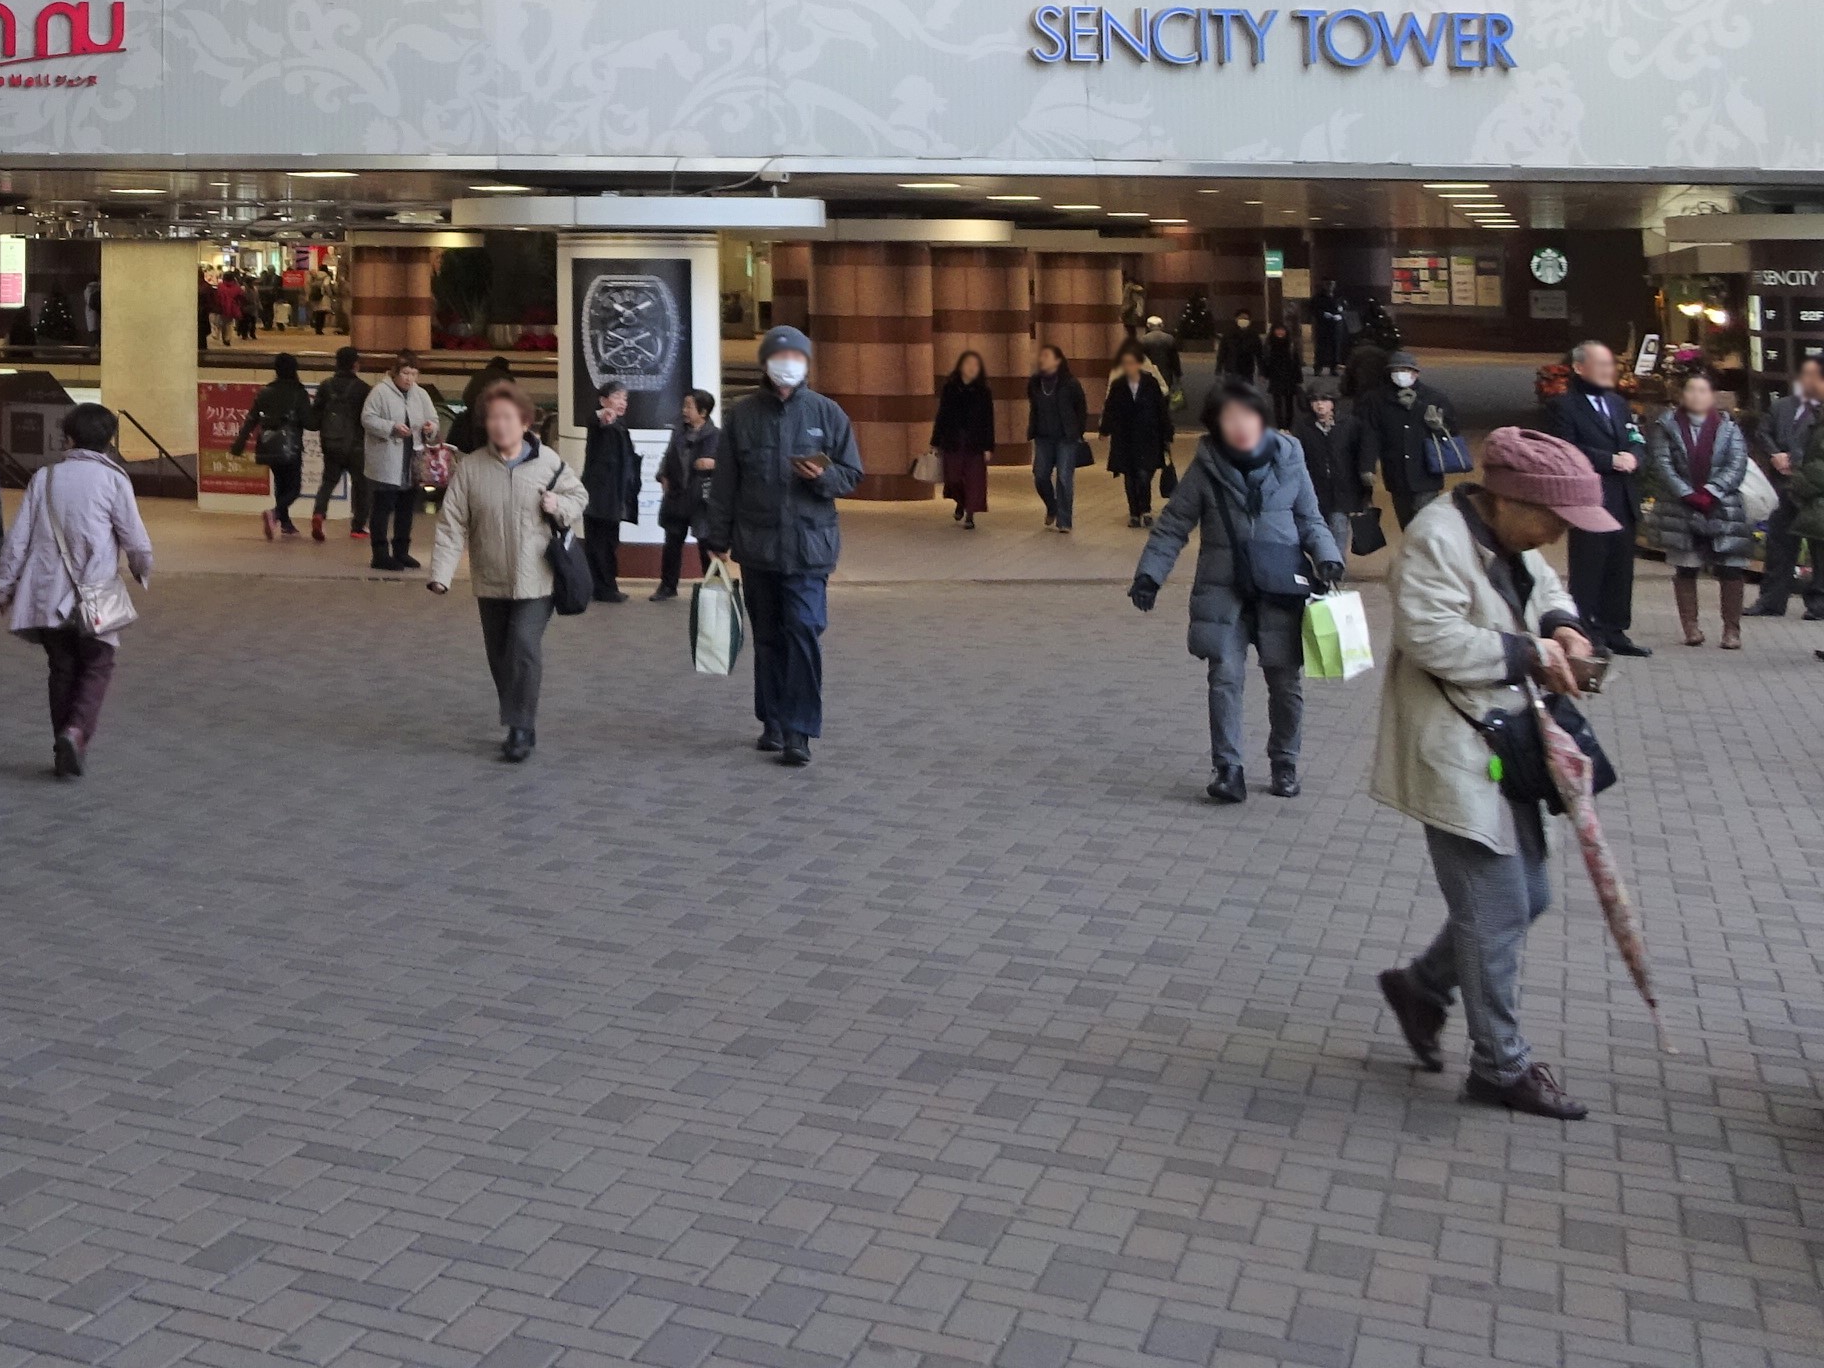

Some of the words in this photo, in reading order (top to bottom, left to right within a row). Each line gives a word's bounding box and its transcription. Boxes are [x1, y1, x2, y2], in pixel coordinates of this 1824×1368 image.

[1029, 4, 1278, 65] SENCITY
[1292, 8, 1518, 71] TOWER
[1761, 269, 1819, 286] SENCITY
[1800, 310, 1824, 322] 22F
[206, 405, 249, 420] クリスマ
